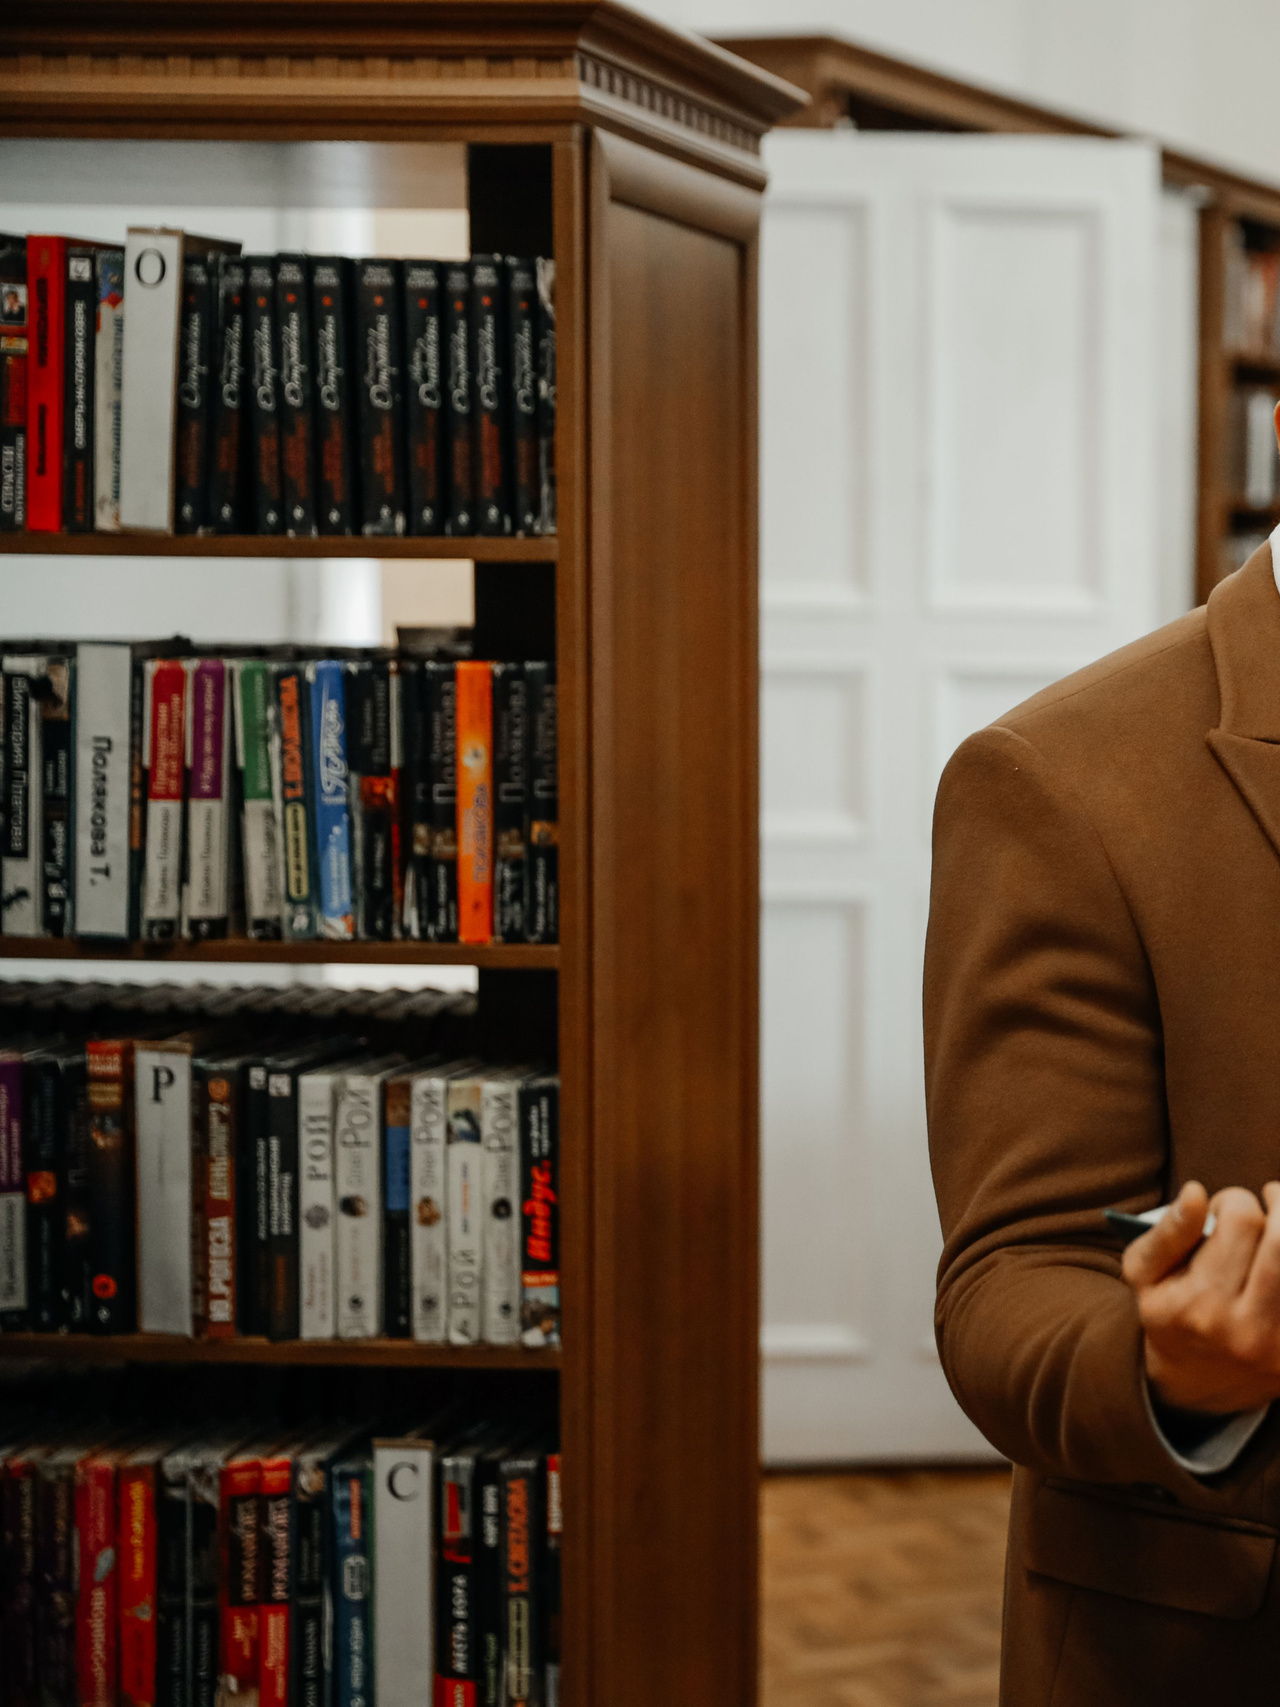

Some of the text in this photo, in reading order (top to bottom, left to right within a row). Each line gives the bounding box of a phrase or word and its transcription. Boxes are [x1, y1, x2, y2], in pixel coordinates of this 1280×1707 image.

[11, 677, 27, 852] Виктория Платова
[89, 735, 112, 887] Полякова Т.
[452, 1574, 469, 1673] МЕСТЬ ВОРА
